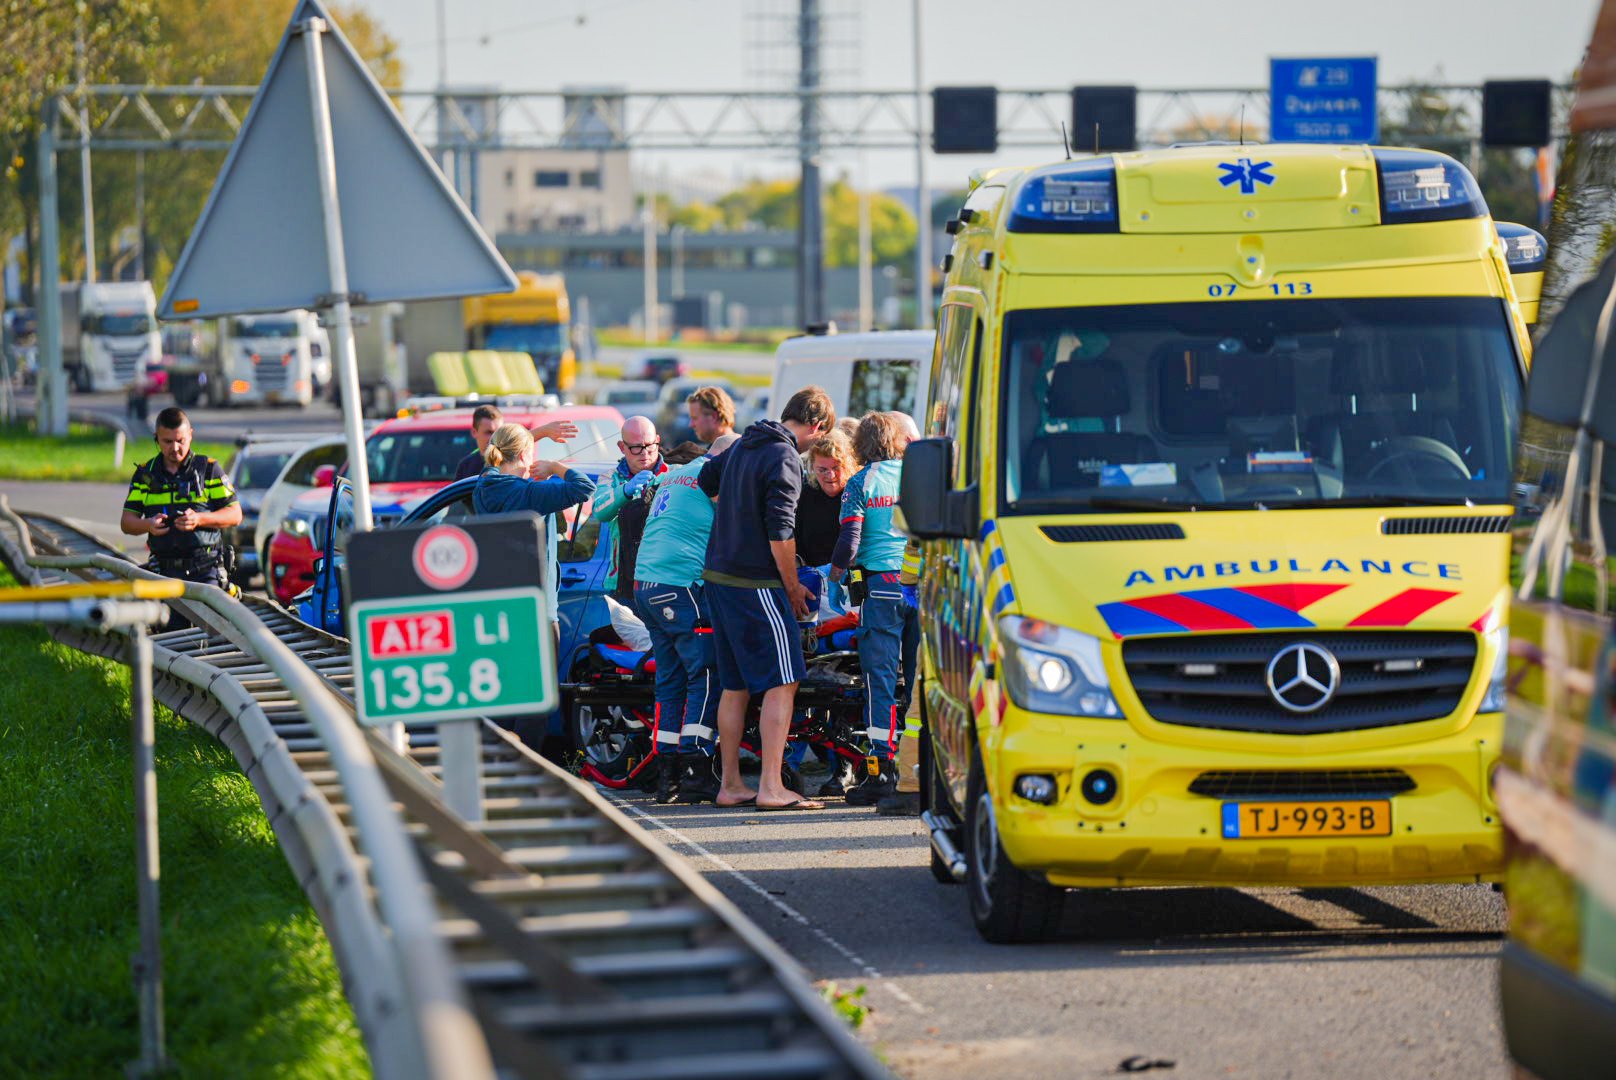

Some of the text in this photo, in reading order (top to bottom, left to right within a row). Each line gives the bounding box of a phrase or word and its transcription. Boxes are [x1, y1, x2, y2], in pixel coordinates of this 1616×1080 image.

[1208, 282, 1312, 297] 07 113
[1124, 558, 1463, 587] AMBULANCE
[379, 617, 445, 651] A12
[370, 658, 501, 710] 135.8
[1249, 806, 1376, 832] TJ-993-B
